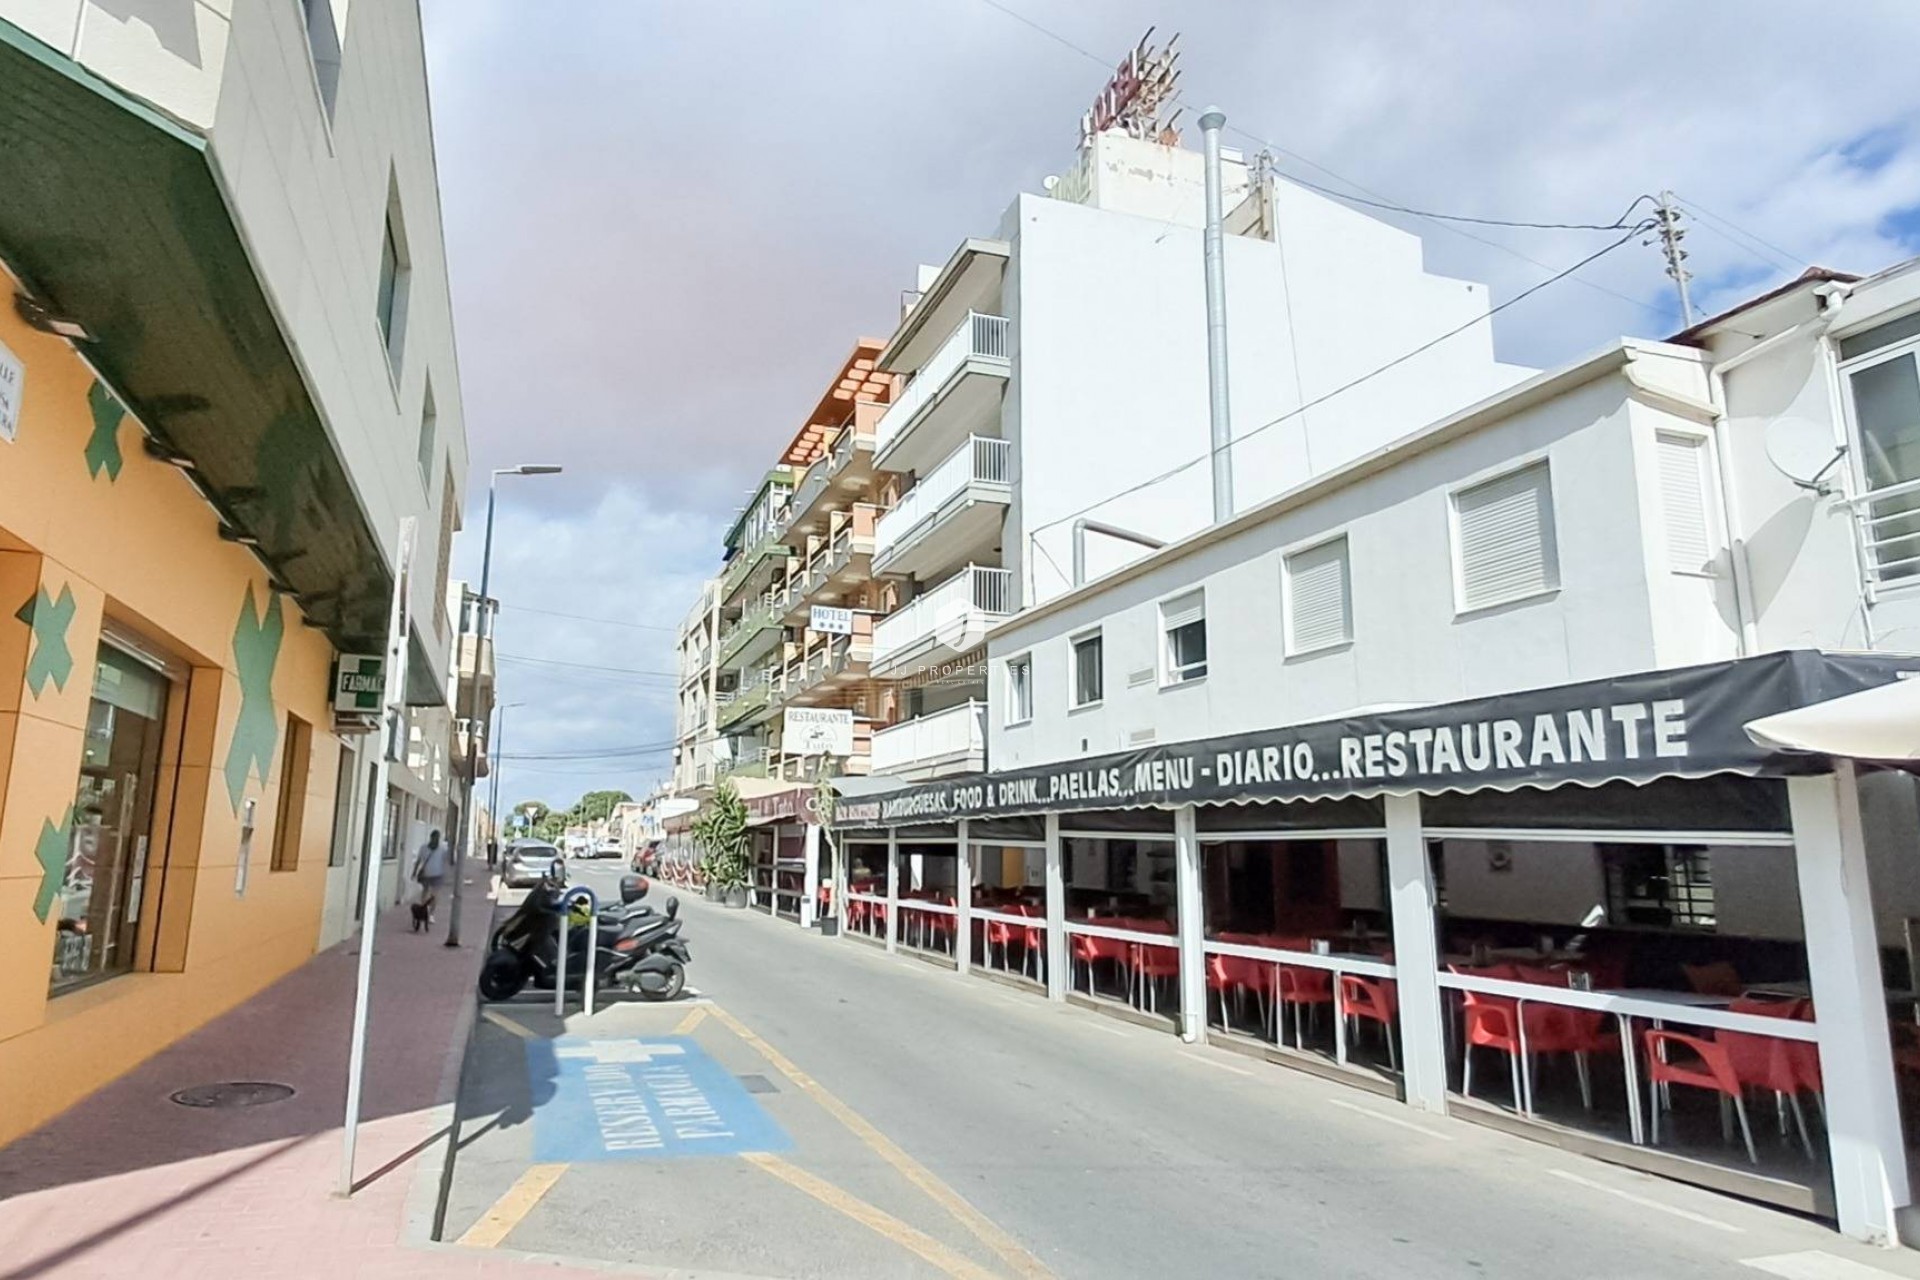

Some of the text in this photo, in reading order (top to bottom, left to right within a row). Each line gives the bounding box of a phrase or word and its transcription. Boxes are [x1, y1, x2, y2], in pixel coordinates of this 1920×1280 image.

[813, 608, 850, 621] HOTEL
[342, 673, 385, 692] FARMAC
[788, 711, 849, 724] RESTAURANTE
[987, 784, 995, 807] &
[1341, 698, 1689, 780] RESTAURANTE
[583, 1064, 665, 1151] RESERVADO
[643, 1065, 735, 1139] FARMACIA
